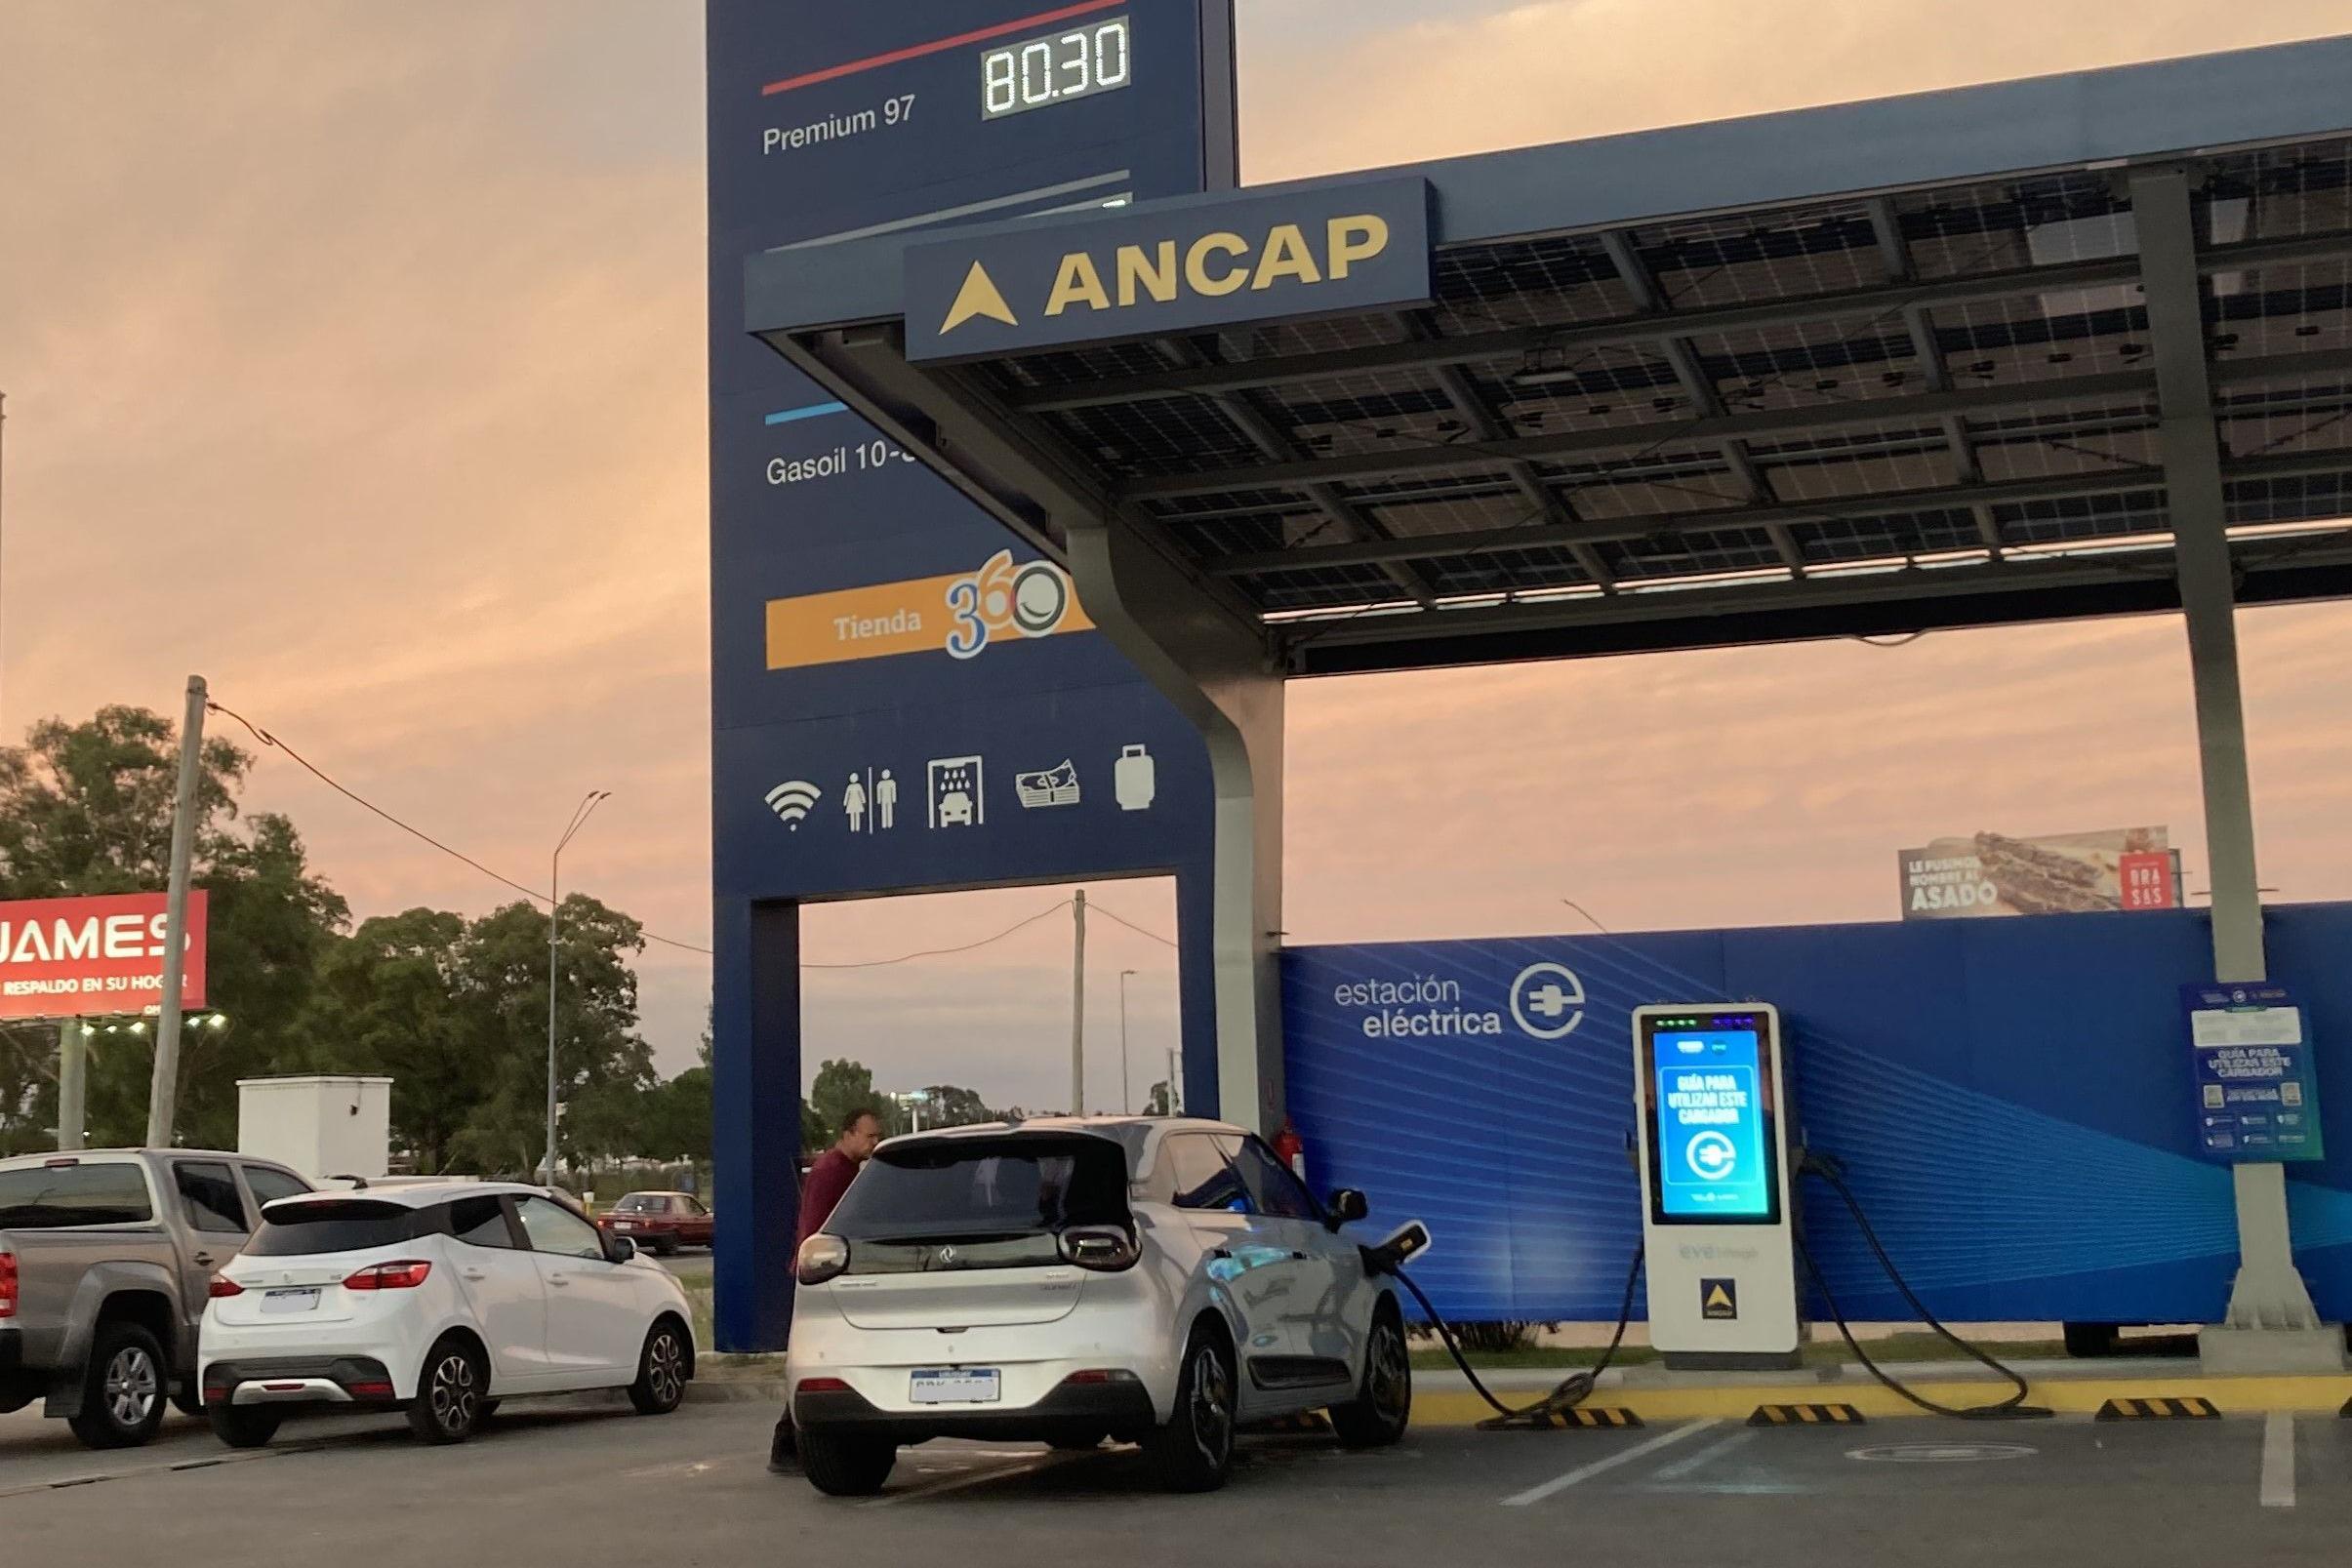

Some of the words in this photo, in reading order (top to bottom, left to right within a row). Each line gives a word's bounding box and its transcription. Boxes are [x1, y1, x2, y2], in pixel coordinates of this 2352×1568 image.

[984, 22, 1127, 113] 80.30
[763, 112, 875, 154] Premium
[883, 94, 916, 126] 97
[1043, 214, 1389, 317] ANCAP
[766, 447, 846, 486] Gasoil
[833, 609, 921, 642] Tienda
[946, 548, 1069, 660] 360
[1912, 879, 1998, 910] ASADO
[4, 979, 79, 996] RESPALDO
[82, 978, 101, 993] EN
[106, 976, 127, 991] SU
[131, 974, 187, 989] HOG
[1334, 974, 1460, 1007] estación
[1362, 1007, 1502, 1038] eléctrica
